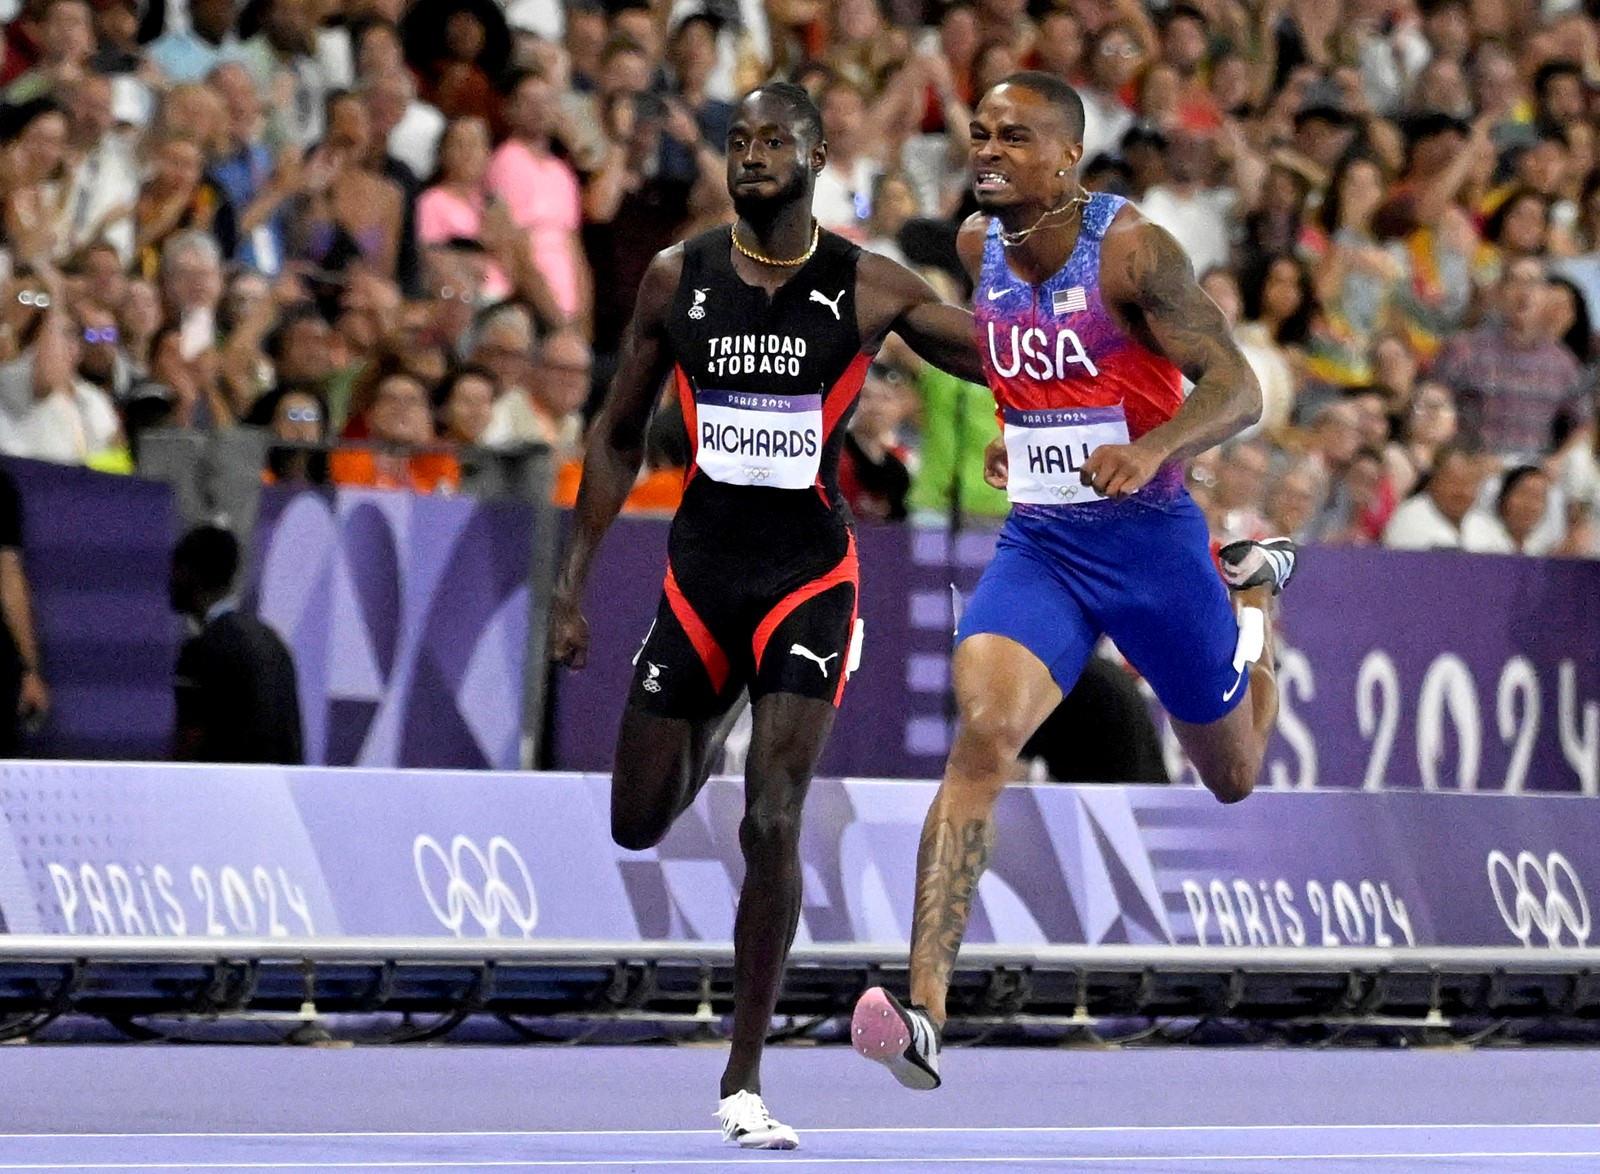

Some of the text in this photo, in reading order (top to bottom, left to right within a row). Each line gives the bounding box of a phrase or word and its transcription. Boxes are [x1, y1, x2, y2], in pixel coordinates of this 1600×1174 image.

[987, 321, 1099, 381] USA
[728, 394, 791, 408] PARIS 2024
[1022, 413, 1088, 423] PARIS 2024
[702, 421, 817, 457] RICHARDS
[190, 864, 314, 936] 2024
[1306, 880, 1415, 947] 2024
